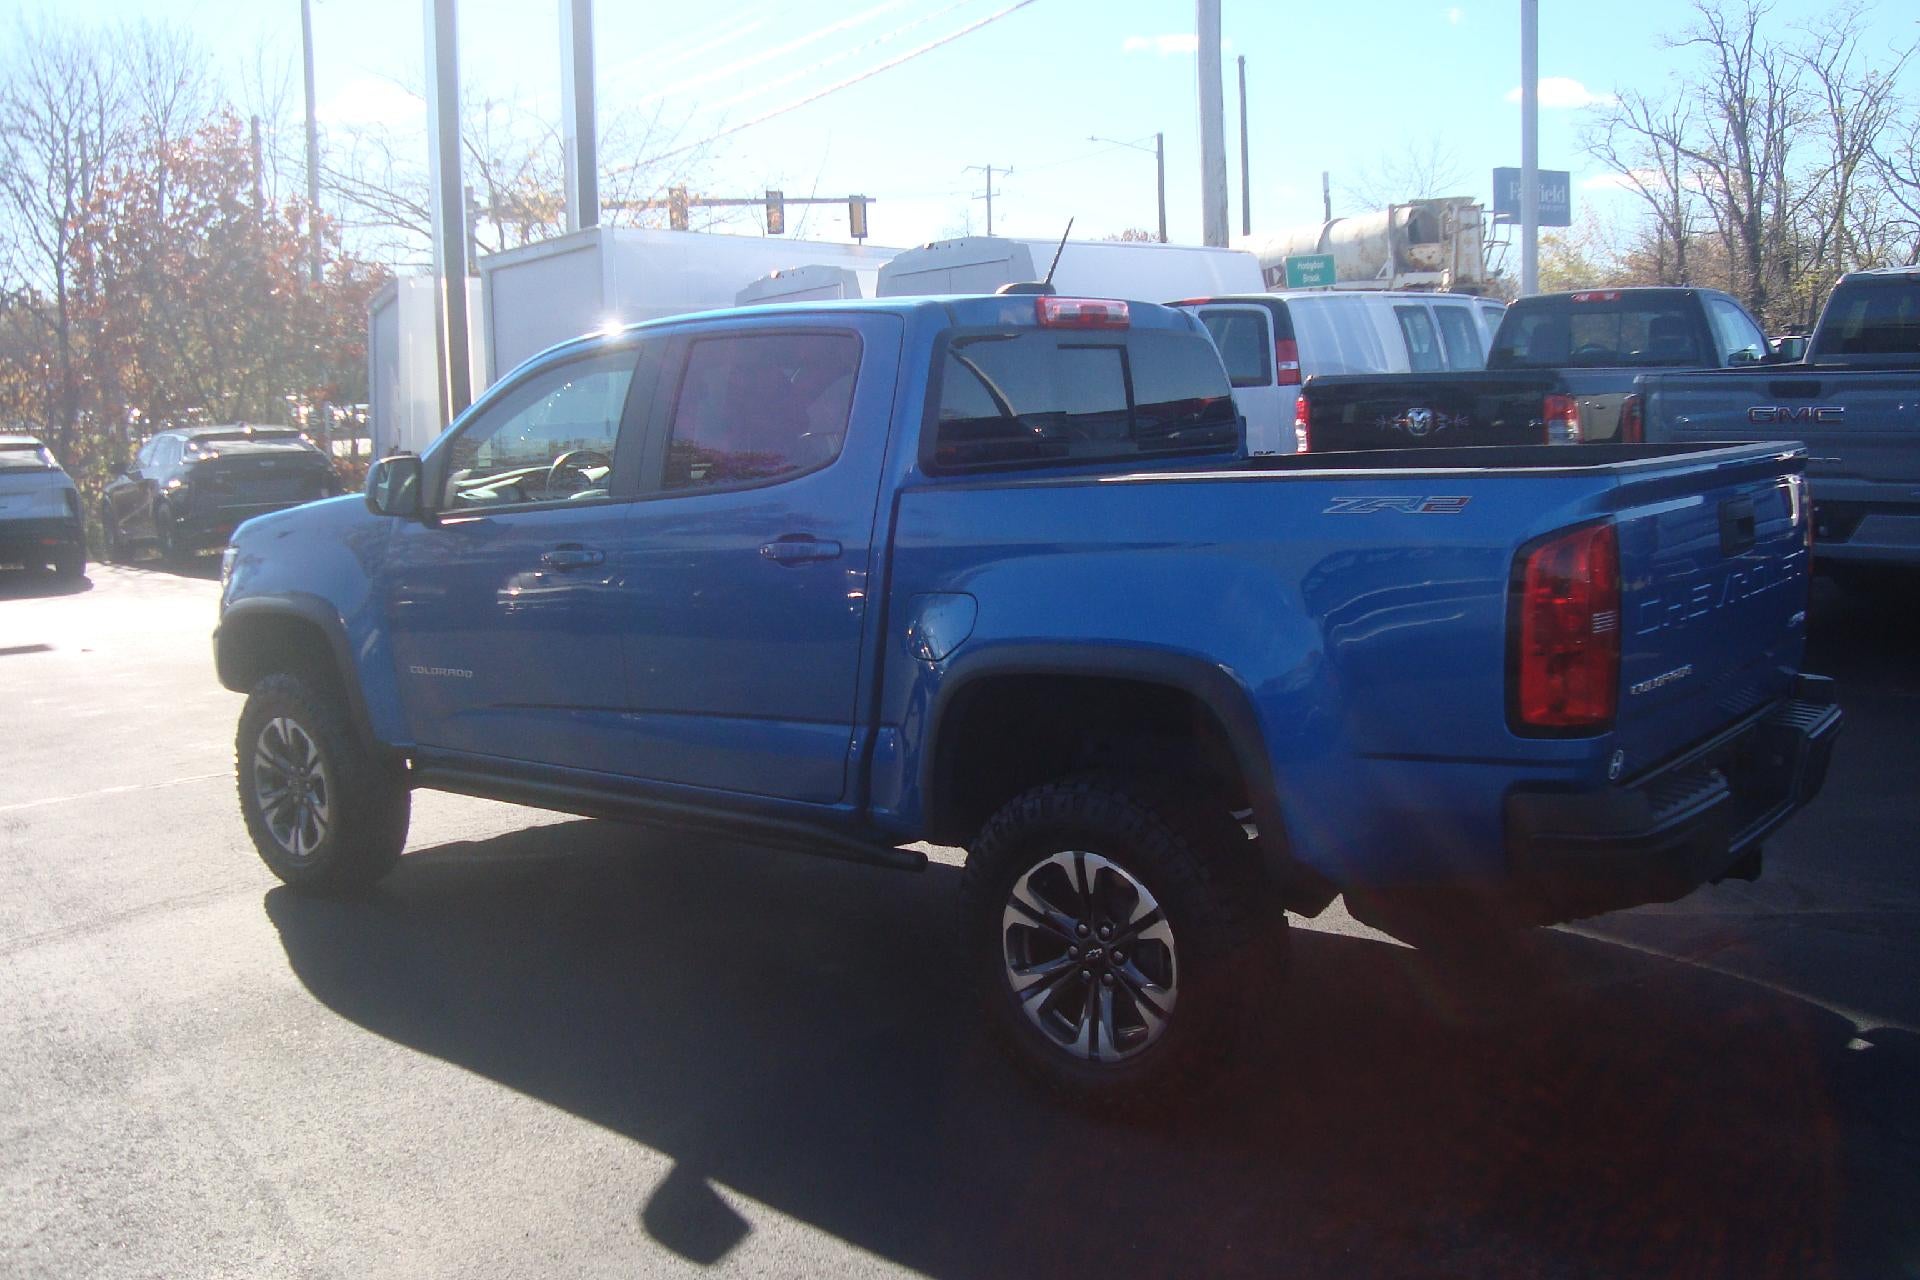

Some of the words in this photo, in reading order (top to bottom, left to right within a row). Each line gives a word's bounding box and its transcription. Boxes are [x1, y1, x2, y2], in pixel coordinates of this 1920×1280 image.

[1747, 406, 1844, 424] GMC
[1322, 495, 1473, 514] ZR2
[409, 665, 473, 678] COLORADO
